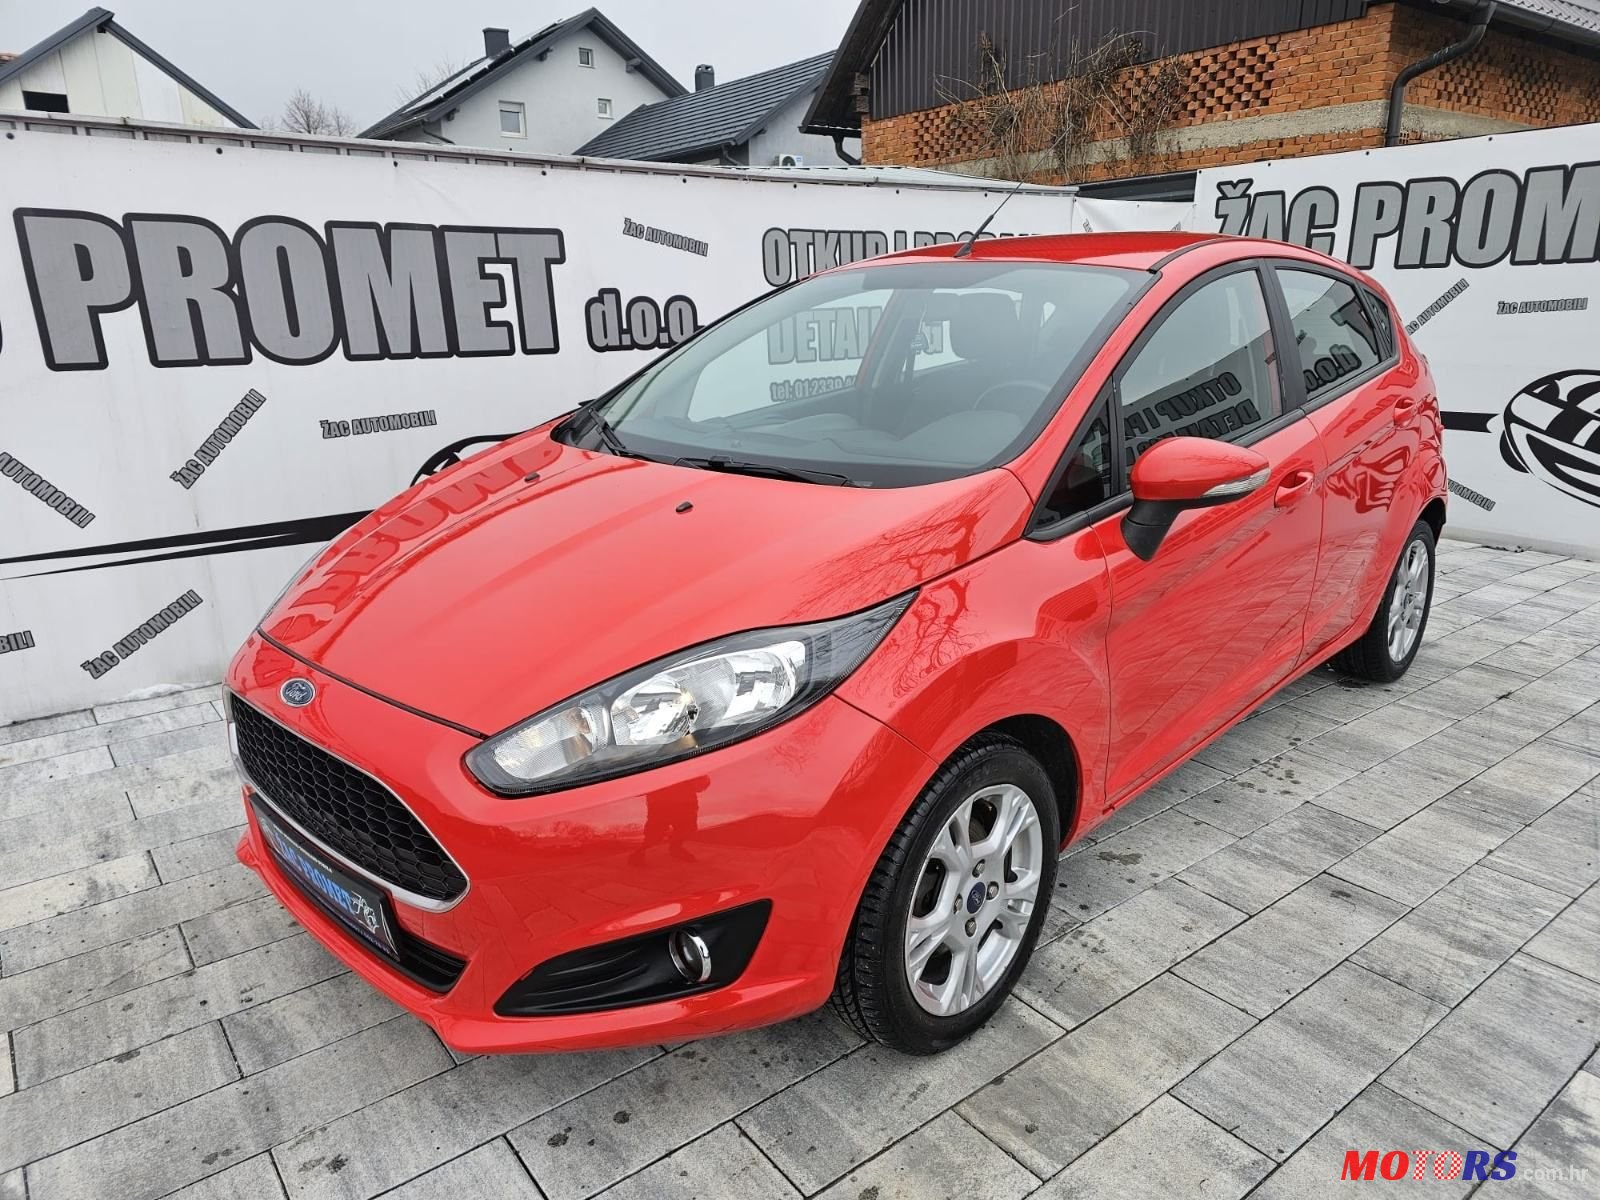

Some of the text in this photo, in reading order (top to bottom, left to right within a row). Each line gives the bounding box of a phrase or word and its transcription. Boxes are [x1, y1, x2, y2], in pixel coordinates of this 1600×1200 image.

[623, 217, 709, 257] ŽAC AUTOMOBILI
[1215, 178, 1339, 256] ŽAC
[12, 207, 566, 372] PROMET
[1416, 277, 1470, 327] AUTOMOBILI
[1518, 297, 1589, 314] AUTOMOBILI
[169, 388, 267, 490] ŽAC AUTOMOBILI
[319, 409, 438, 440] ŽAC AUTOMOBILI
[80, 589, 204, 680] ŽAC AUTOMOBILI
